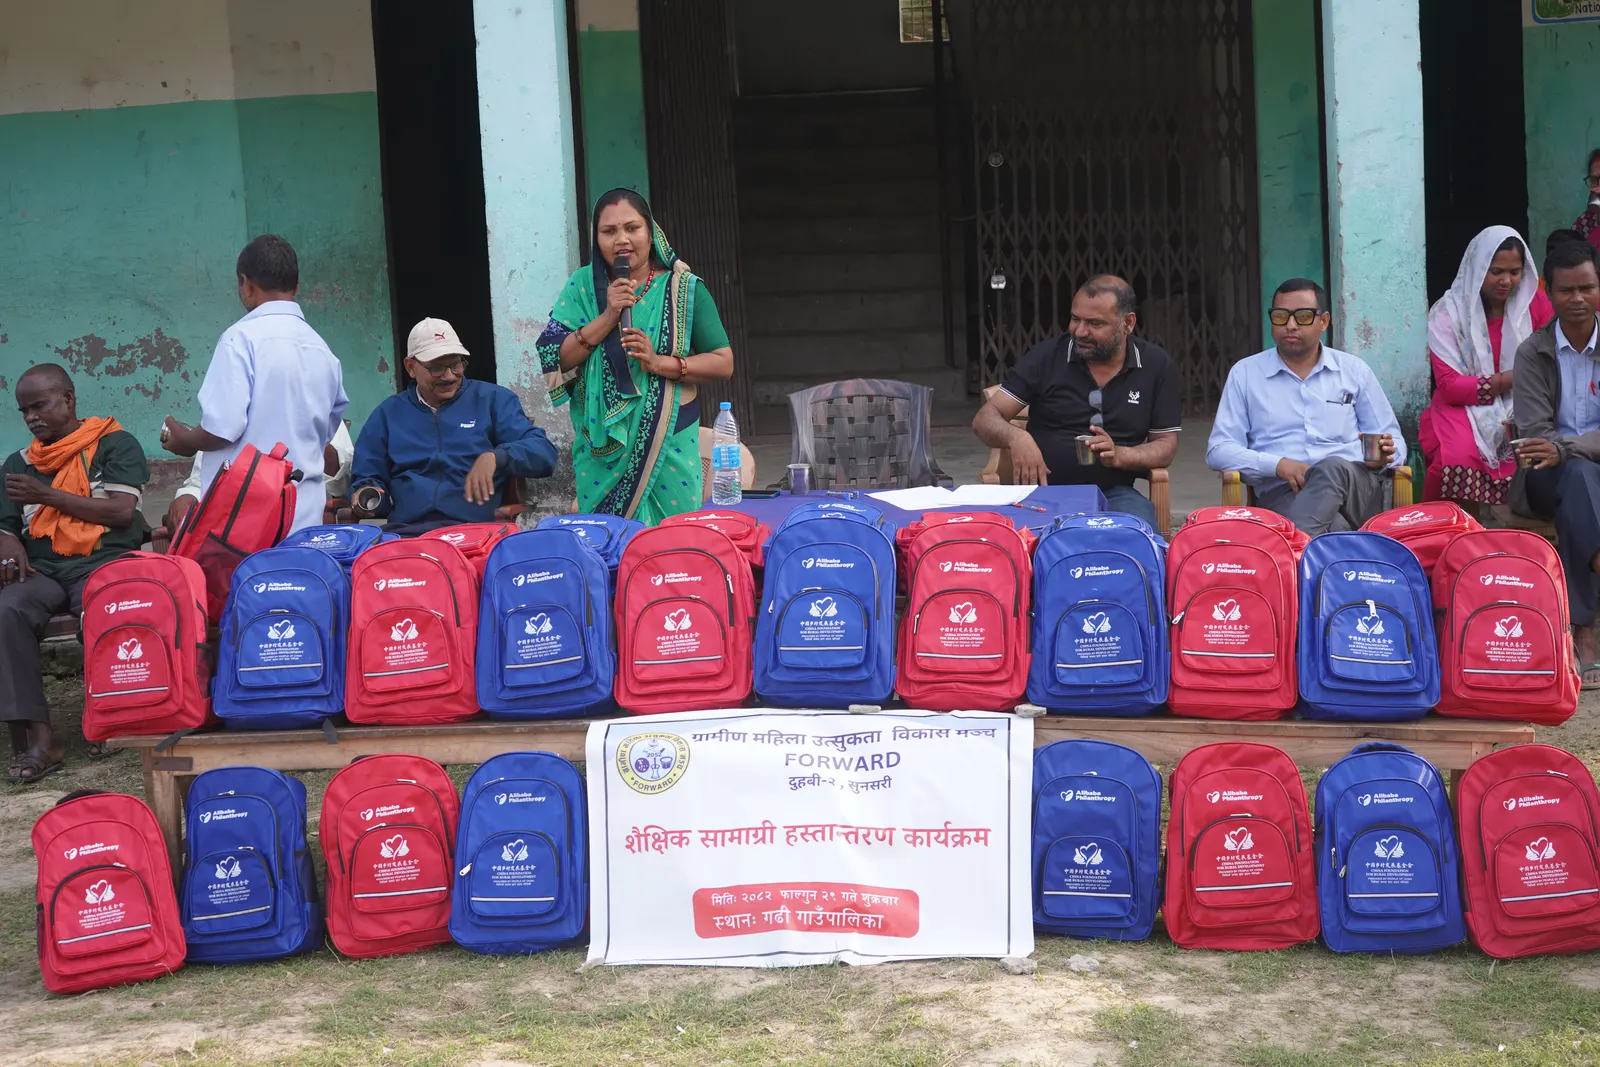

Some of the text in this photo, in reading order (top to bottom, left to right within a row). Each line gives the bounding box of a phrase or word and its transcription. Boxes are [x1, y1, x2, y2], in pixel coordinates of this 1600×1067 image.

[527, 573, 563, 583] Philanthropy
[1358, 576, 1395, 584] Philanthropy
[388, 580, 426, 588] Philanthropy
[1495, 580, 1534, 588] Philanthropy
[118, 602, 152, 611] Philanthropy
[692, 725, 997, 751] ग्रामीण महिला उत्सुकता विकास मञ्च
[785, 751, 901, 772] FORWARD
[633, 777, 674, 791] FORWARD
[848, 775, 892, 794] सुनसरी
[1519, 798, 1559, 807] Philanthropy
[213, 812, 248, 820] Philanthropy
[376, 806, 414, 817] Philanthropy
[625, 820, 991, 854] शैक्षिक सामाग्री हस्तान्तरण कार्यक्रम
[80, 843, 104, 851] Alibaba
[80, 845, 119, 856] Philanthropy
[742, 891, 771, 903] २०८२
[780, 890, 817, 903] फाल्गुन
[822, 891, 835, 900] २९
[841, 890, 858, 902] गते
[762, 905, 791, 924] गढी
[795, 905, 884, 928] गाउँपालिका
